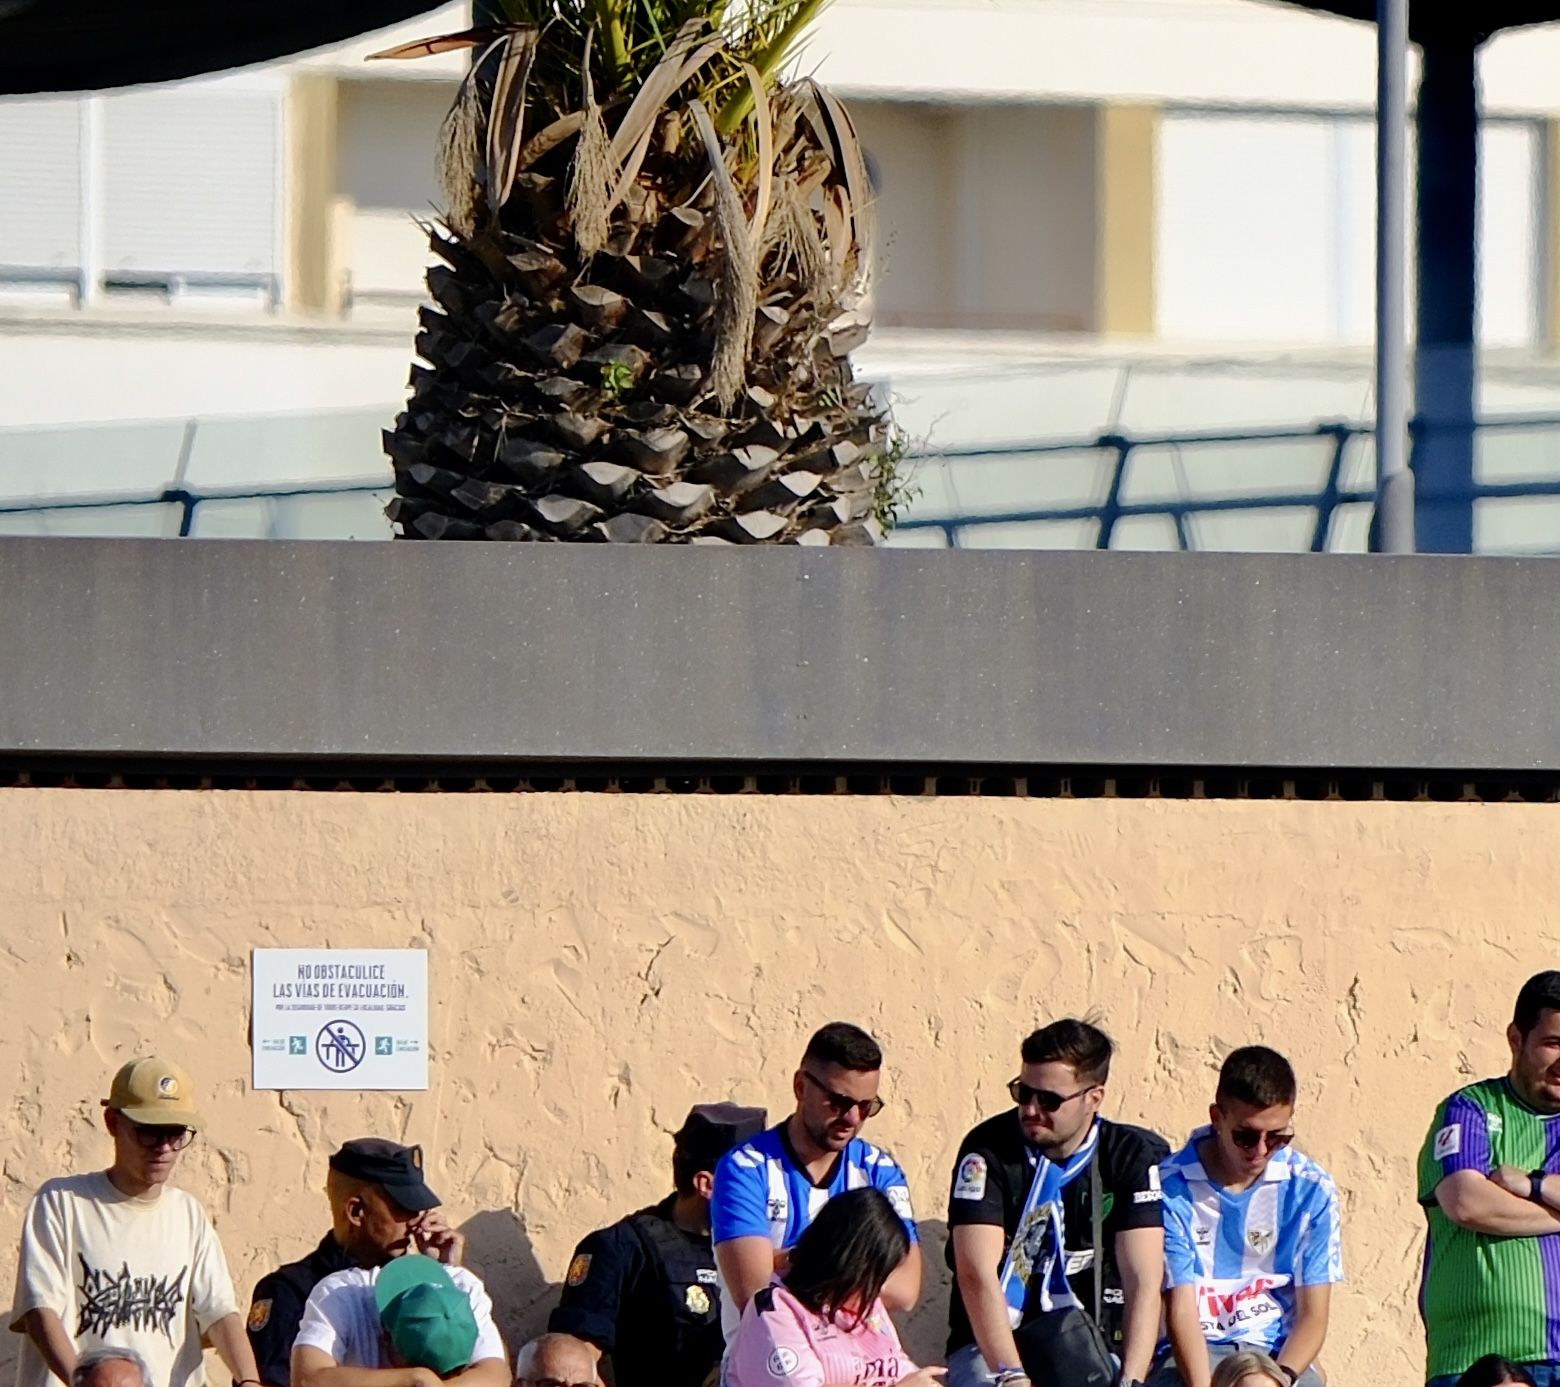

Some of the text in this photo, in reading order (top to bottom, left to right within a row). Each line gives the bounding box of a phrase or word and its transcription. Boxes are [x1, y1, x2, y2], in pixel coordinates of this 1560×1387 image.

[298, 963, 385, 980] NO OBSTACULICE
[273, 983, 292, 999] LAS
[322, 983, 335, 999] DE
[338, 979, 408, 999] EVACUACIÓN.
